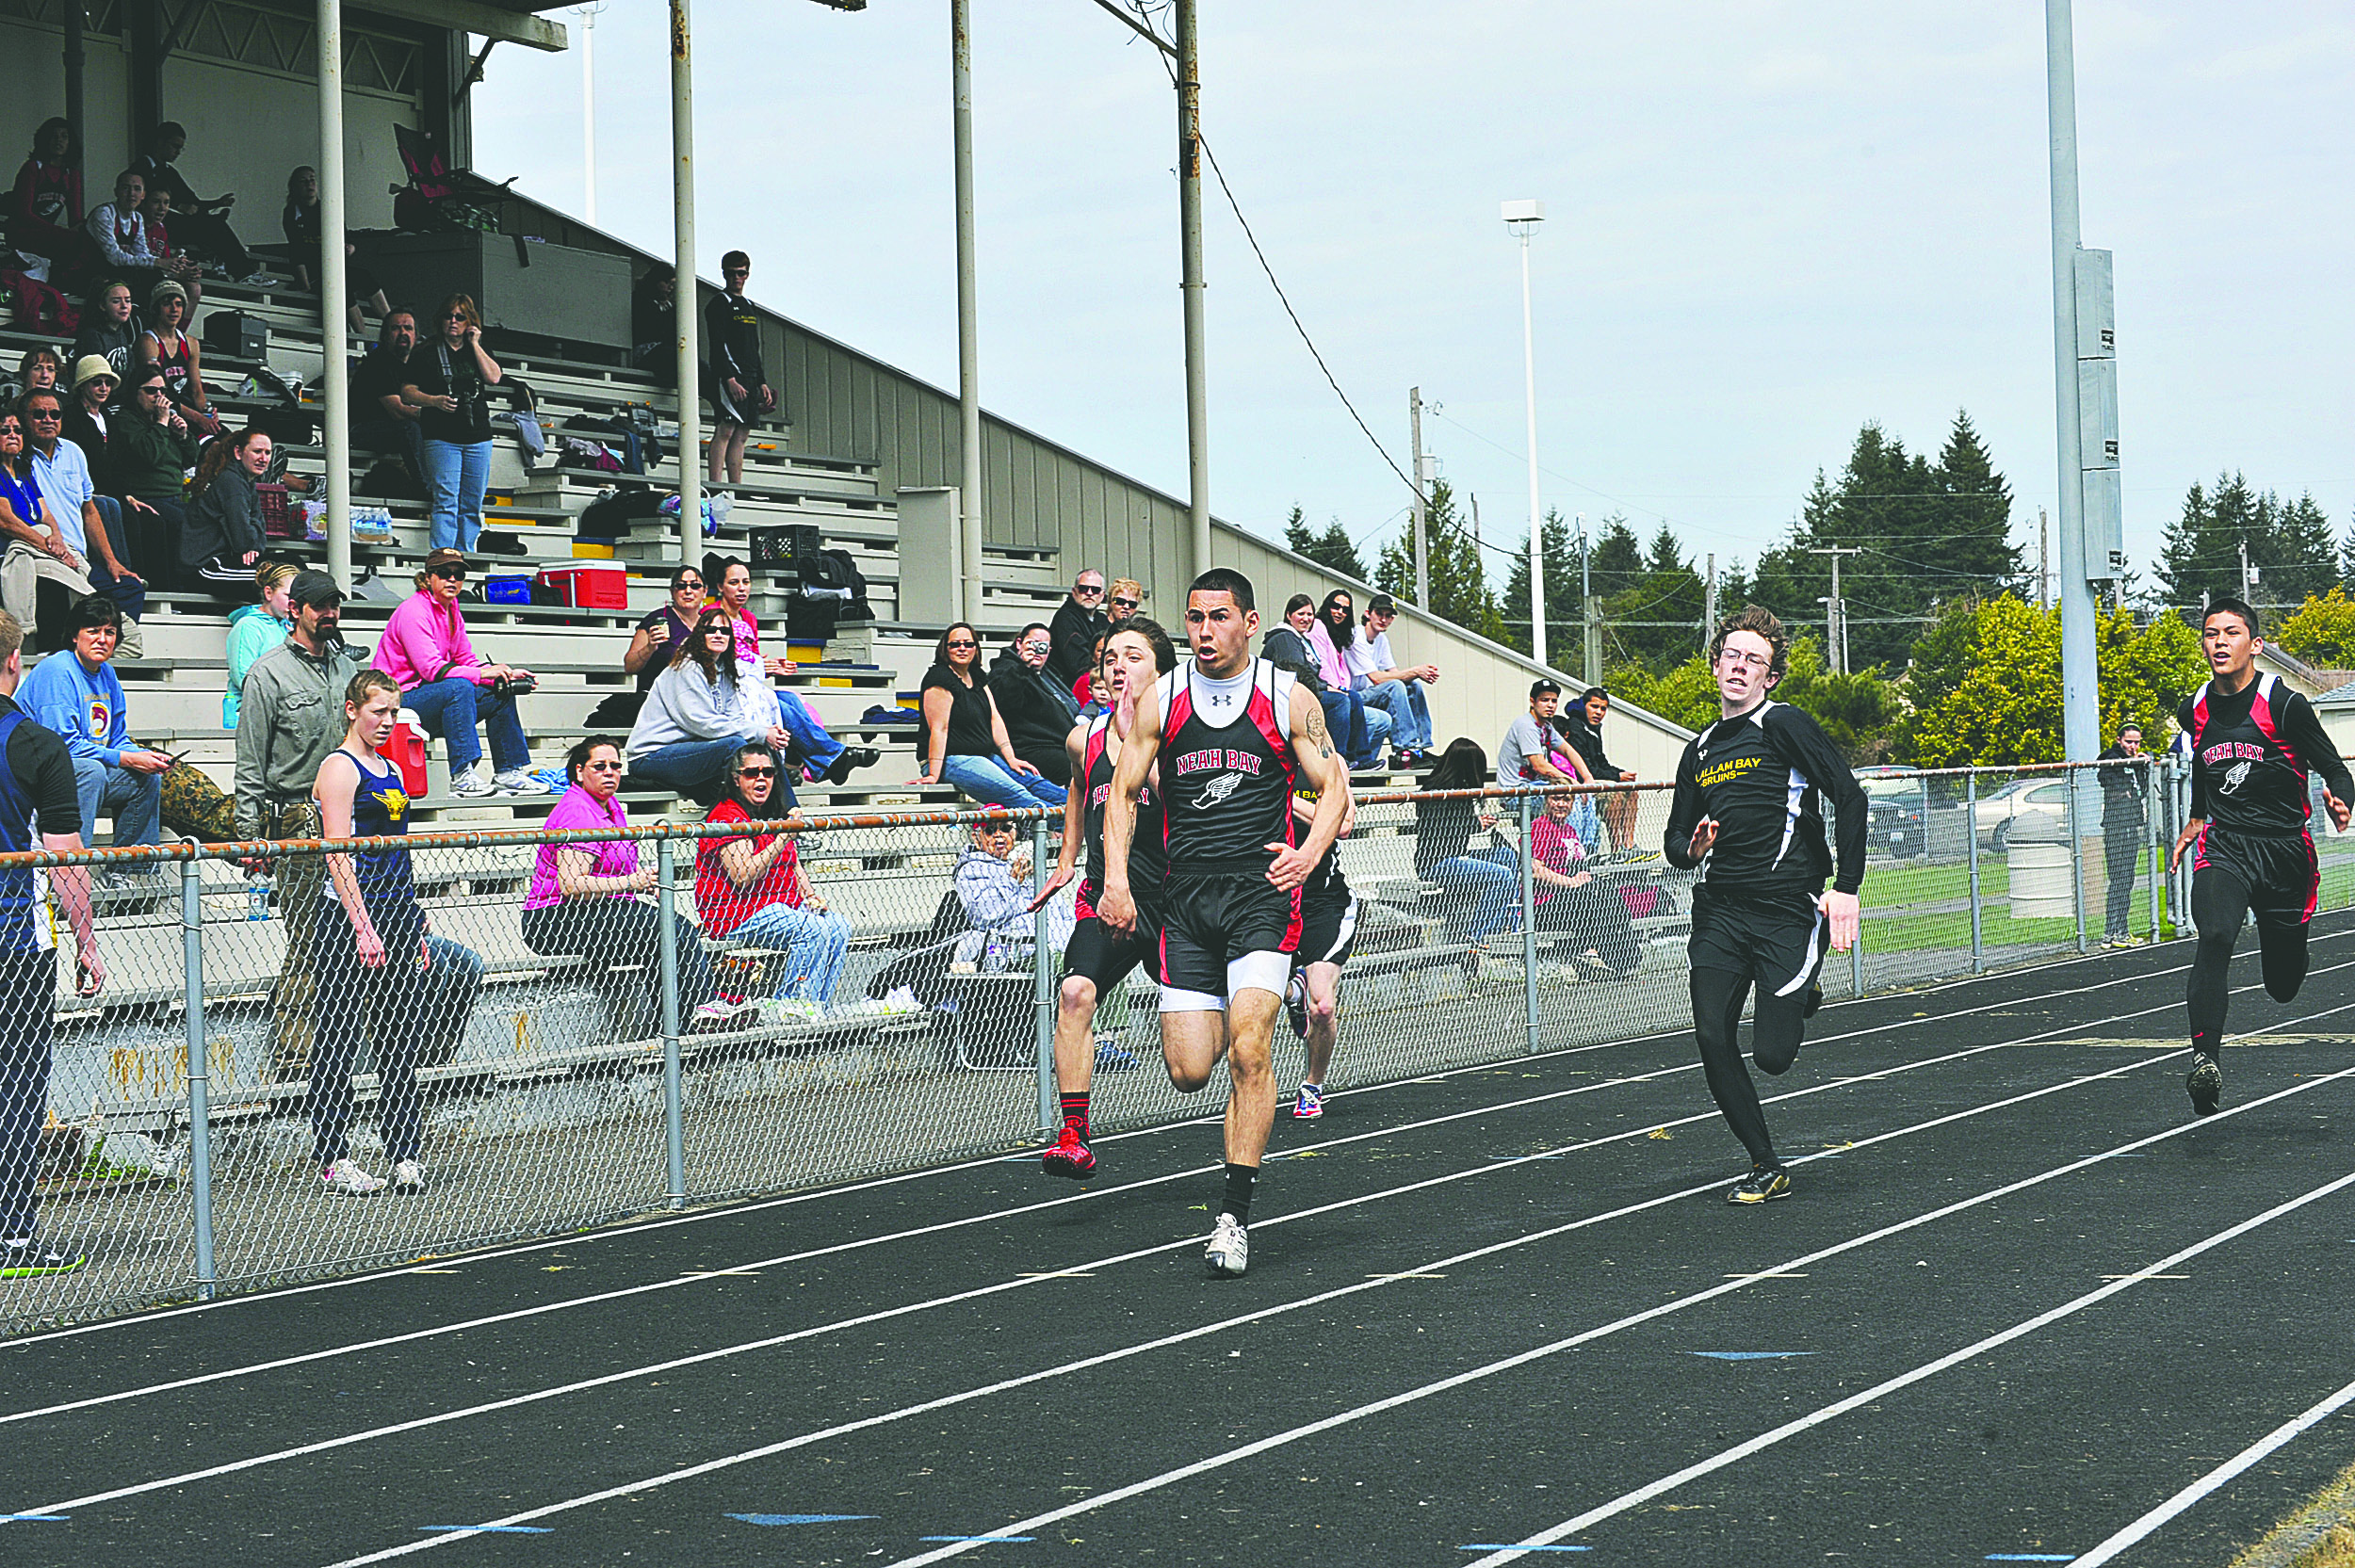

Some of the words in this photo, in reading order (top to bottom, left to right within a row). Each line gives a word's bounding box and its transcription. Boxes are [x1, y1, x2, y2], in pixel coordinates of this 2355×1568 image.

[1177, 749, 1222, 776] NEAH
[1226, 749, 1261, 775] BAY
[2202, 742, 2233, 766] NEAH
[2234, 742, 2264, 762] BAY
[1696, 761, 1733, 783] LALLAM
[1735, 757, 1762, 768] BAY
[1093, 784, 1111, 810] EA
[1303, 790, 1317, 799] BA
